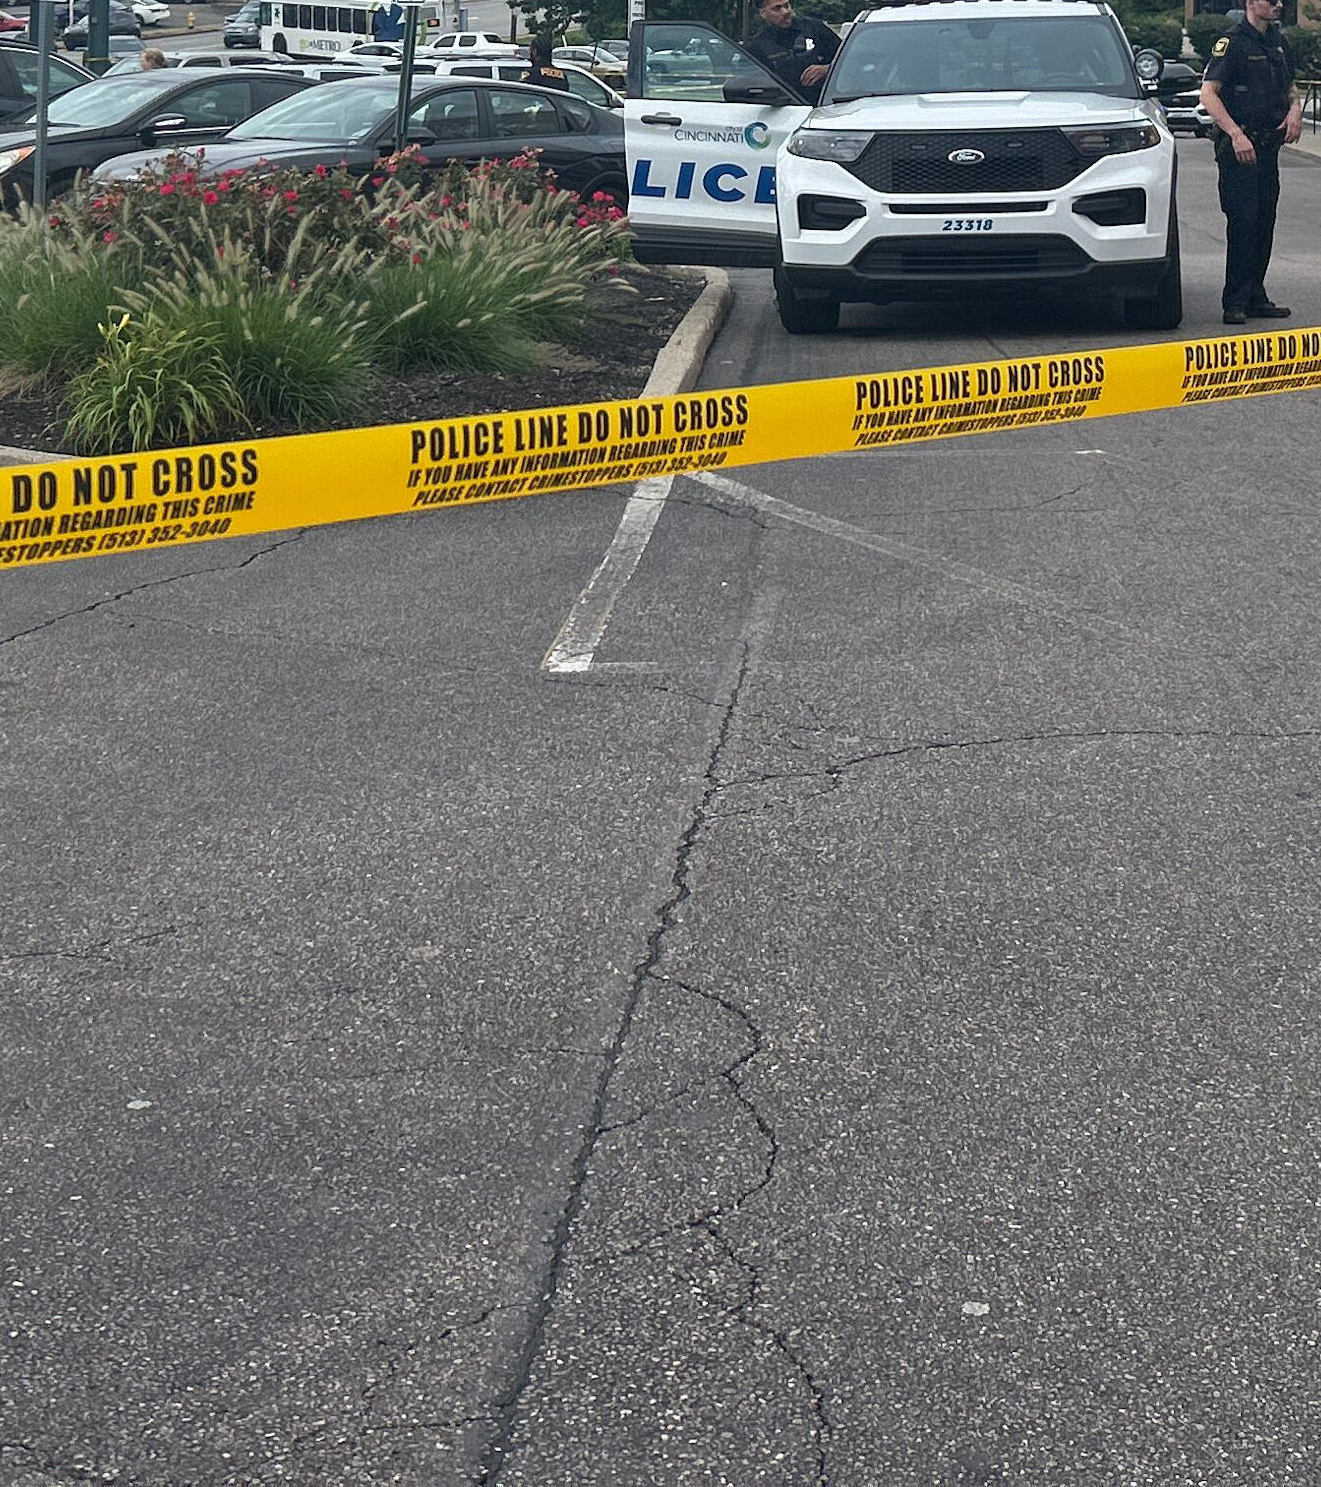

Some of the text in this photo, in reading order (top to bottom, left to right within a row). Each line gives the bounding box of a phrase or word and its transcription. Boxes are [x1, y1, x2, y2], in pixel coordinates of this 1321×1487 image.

[674, 130, 744, 143] CINCINNATI
[957, 153, 976, 161] Ford
[942, 219, 993, 231] 23318
[1185, 342, 1238, 372] POLICE
[1243, 338, 1273, 364] LINE
[1278, 335, 1296, 361] DO
[855, 356, 1104, 411] POLICE LINE DO NOT CROSS
[410, 394, 749, 464] POLICE LINE DO NOT CROSS
[852, 415, 864, 430] IF
[864, 412, 886, 428] YOU
[886, 408, 913, 426] HAVE
[912, 405, 934, 423] ANY
[934, 398, 999, 421] INFORMATION
[1051, 390, 1073, 406] THIS
[407, 429, 746, 488] IF YOU HAVE ANY INFORMATION REGARDING THIS CRIME
[854, 430, 891, 447] PLEASE
[12, 471, 57, 514] DO
[73, 463, 137, 506] NOT
[152, 449, 258, 497] CROSS
[412, 487, 463, 507] PLEASE
[465, 478, 526, 499] CONTACT
[527, 466, 633, 491] CRIMESTOPPERS
[58, 507, 157, 534] REGARDING
[162, 498, 200, 520] THIS
[203, 491, 256, 515] CRIME
[98, 530, 143, 550] (513)
[147, 518, 232, 544] 352-3040
